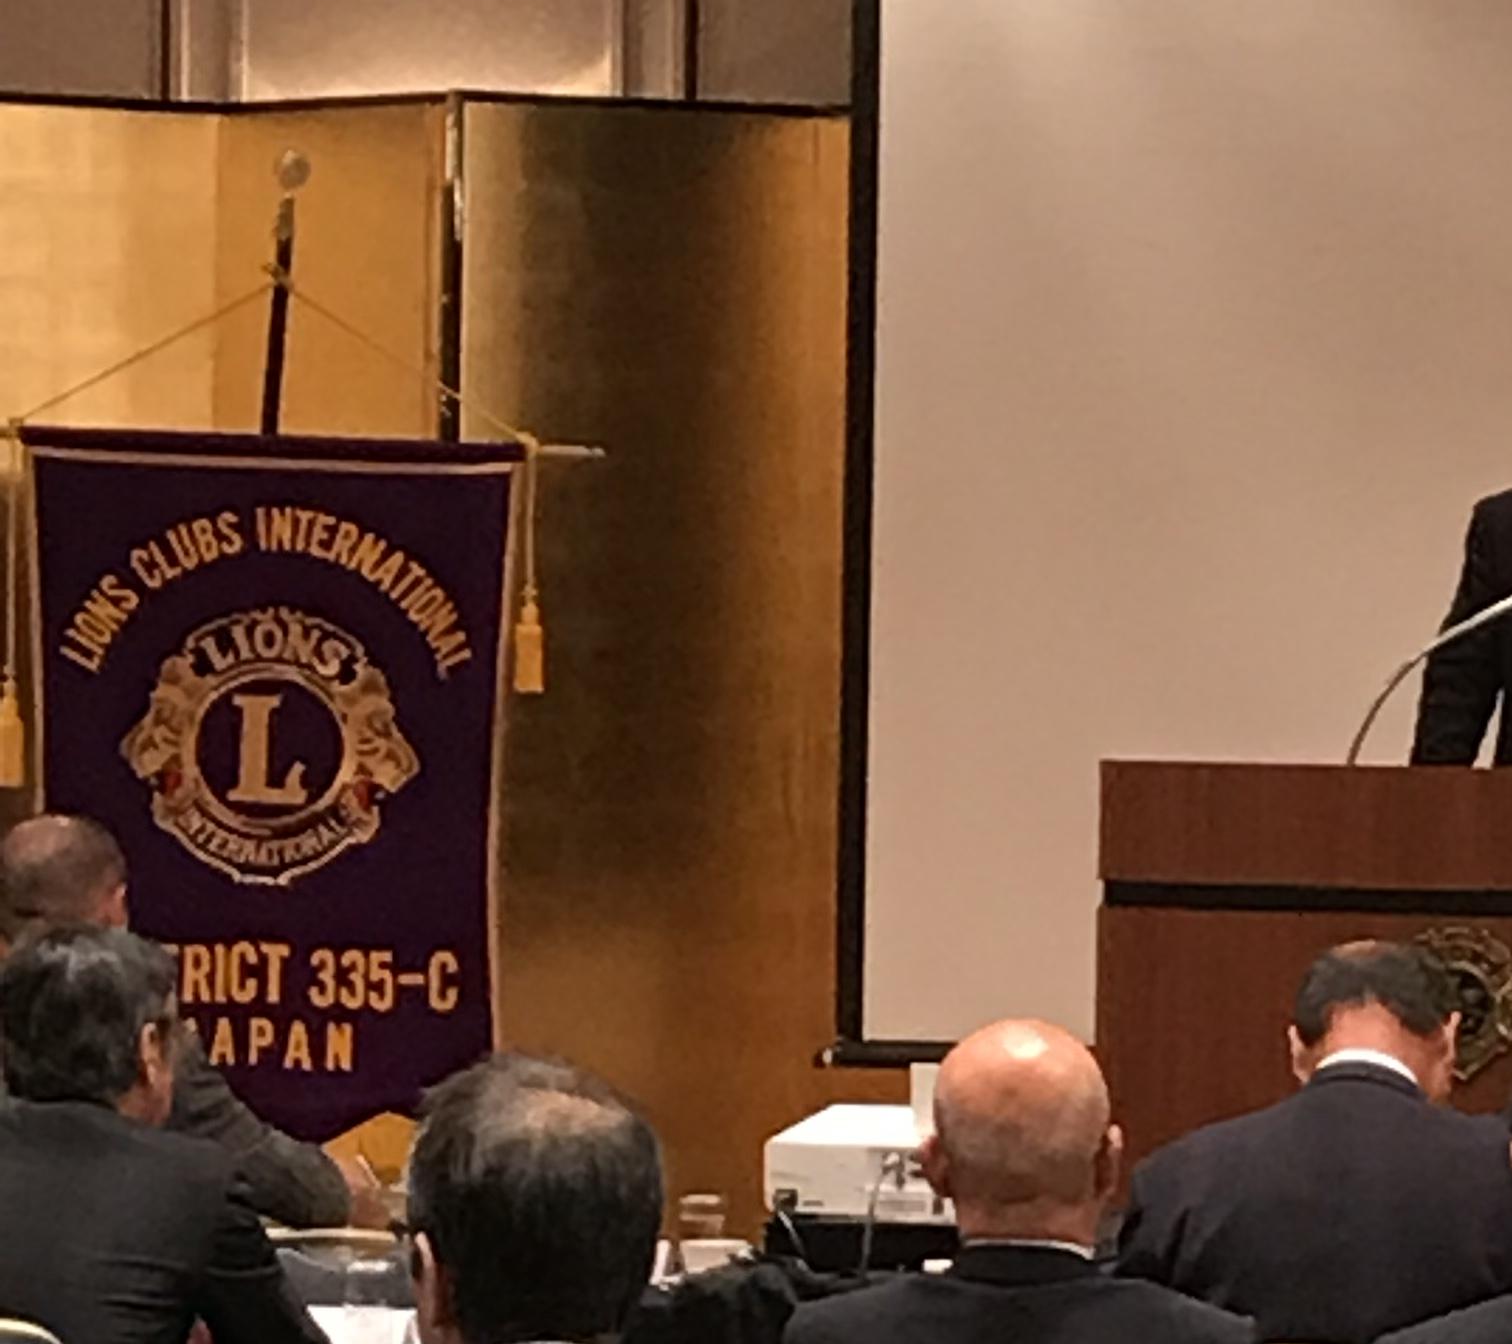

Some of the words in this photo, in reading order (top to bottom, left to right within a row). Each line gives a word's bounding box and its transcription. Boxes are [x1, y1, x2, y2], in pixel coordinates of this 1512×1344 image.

[60, 574, 140, 674] LIONS
[130, 510, 243, 589] CLUBS
[254, 506, 472, 681] INTERNATIONAL
[200, 619, 351, 678] LIONS
[226, 693, 308, 805] L
[160, 940, 291, 1005] RICT
[308, 948, 459, 1012] 335-C
[183, 1016, 354, 1072] APAN
